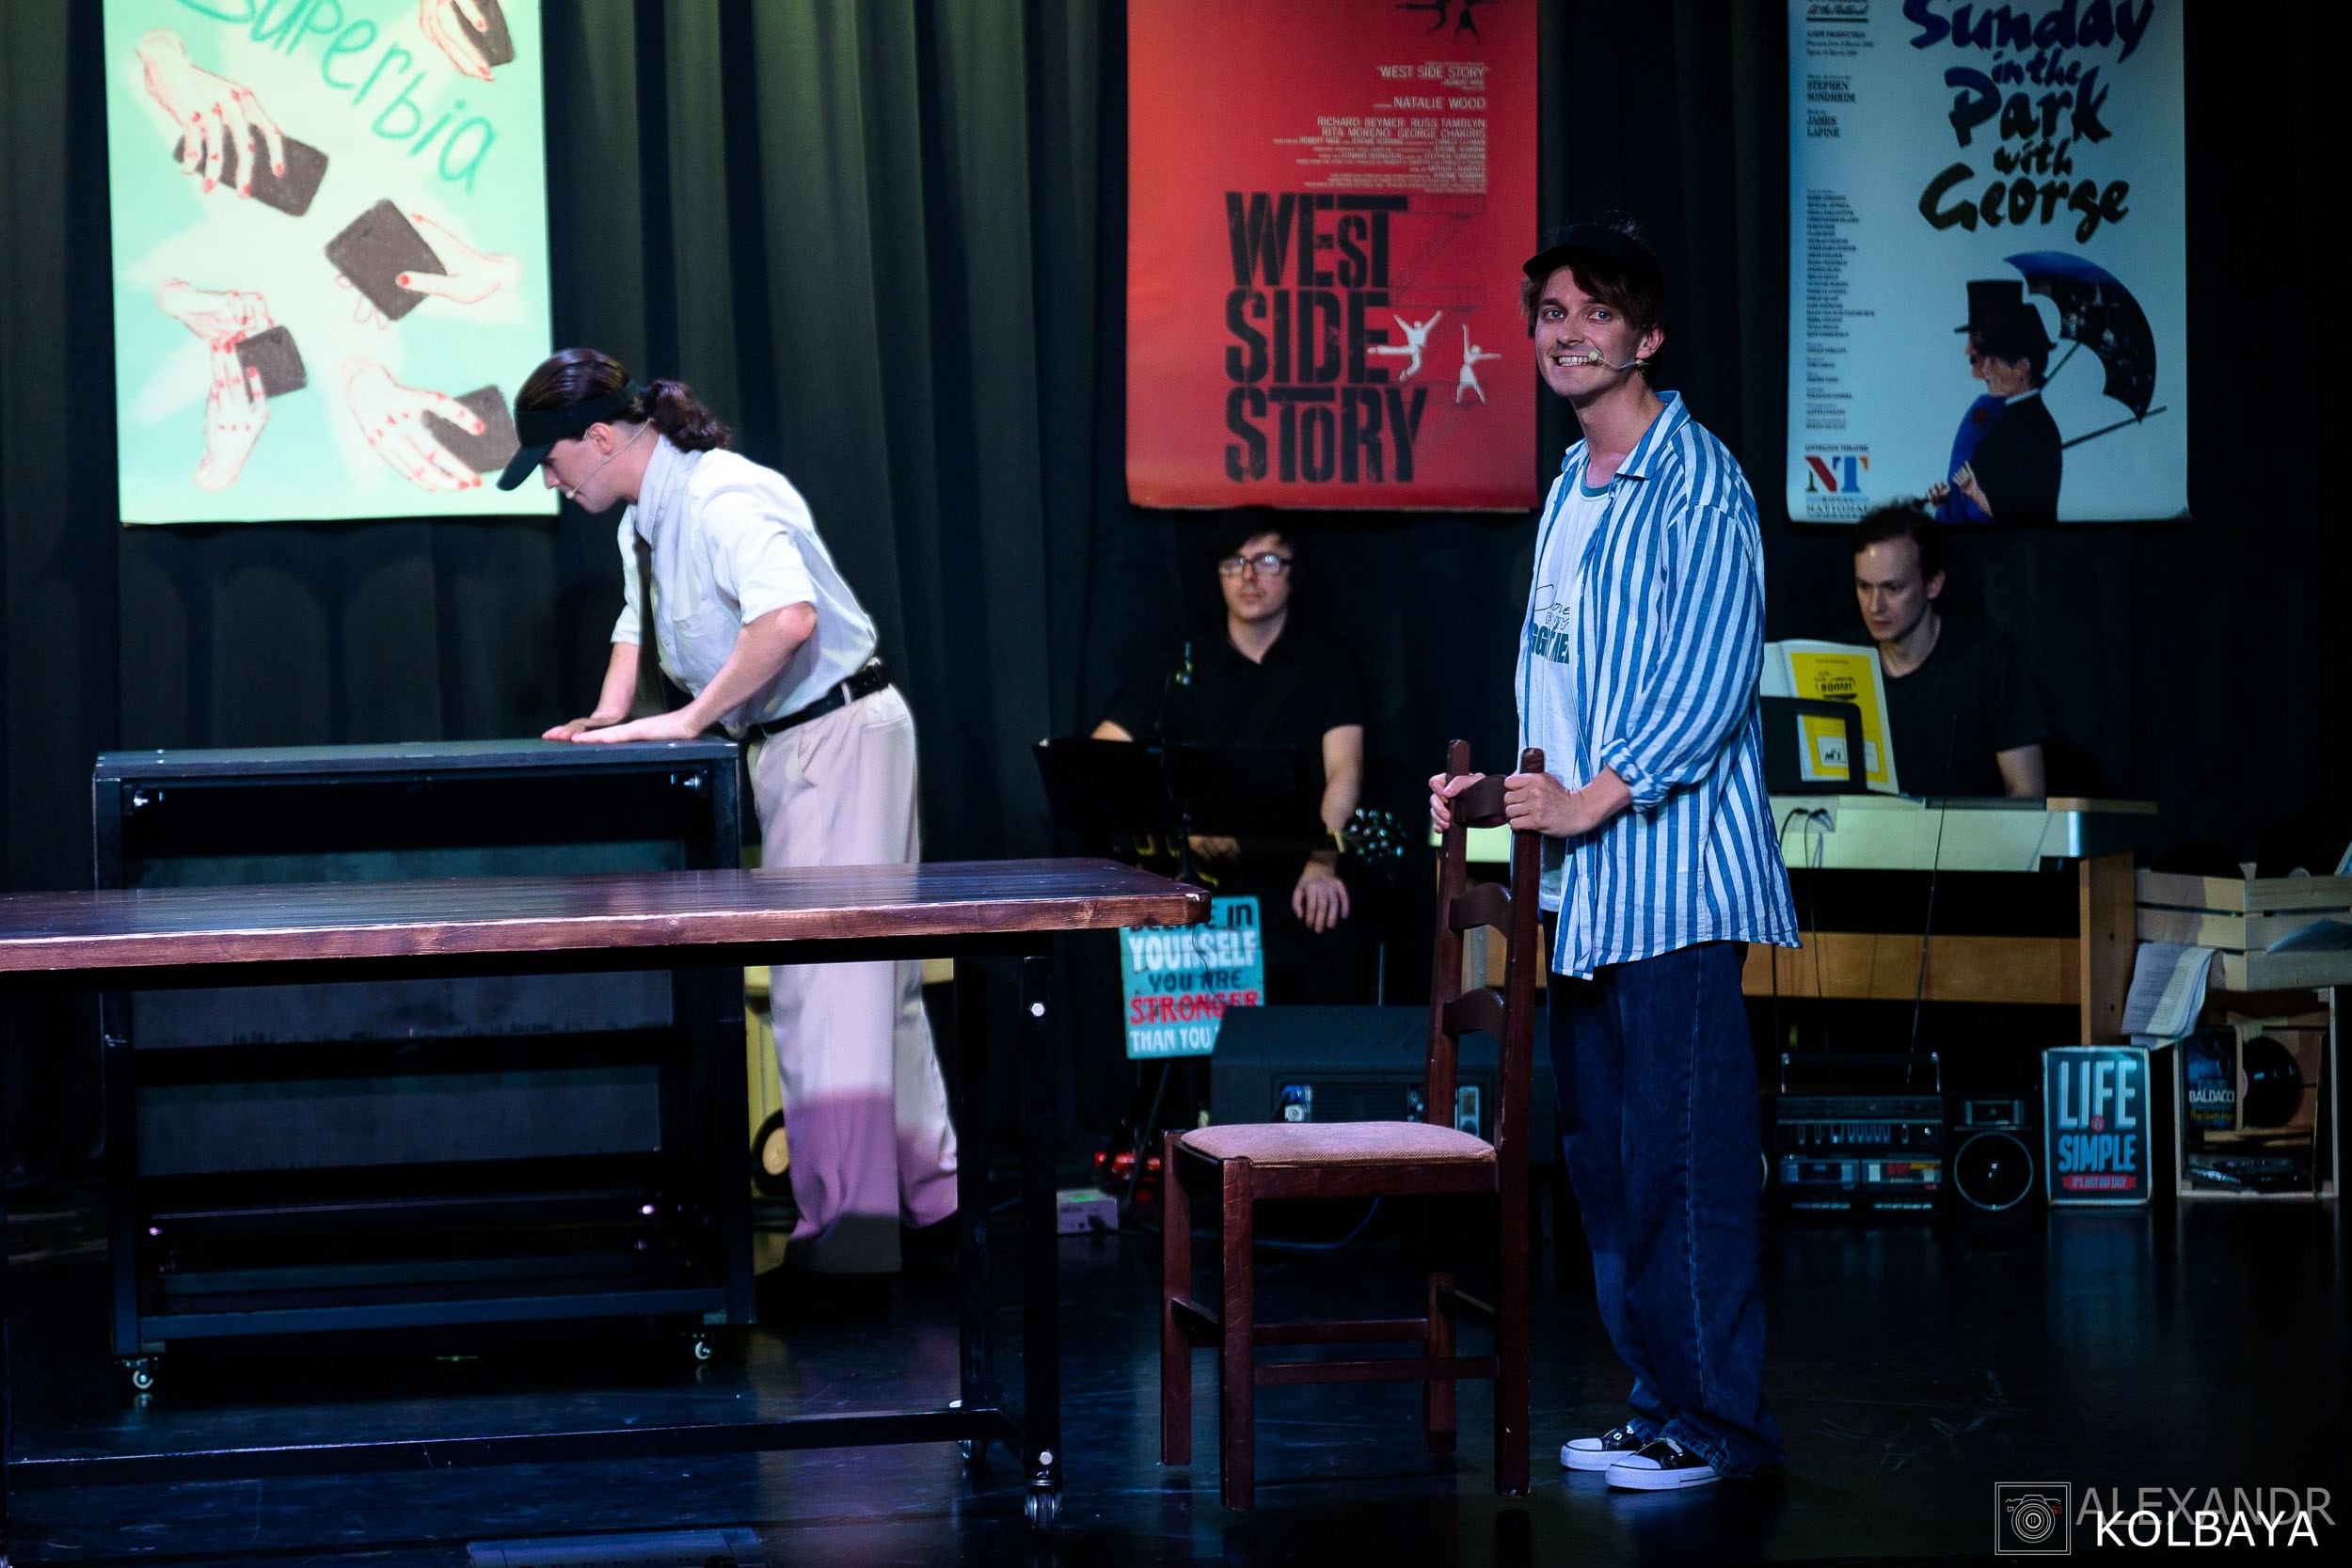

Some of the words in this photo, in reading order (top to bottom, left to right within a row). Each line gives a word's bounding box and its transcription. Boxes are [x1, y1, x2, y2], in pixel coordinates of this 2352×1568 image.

[1902, 0, 2154, 63] Sunday
[1417, 65, 1443, 79] SIDE
[1991, 51, 2026, 85] in
[2026, 49, 2081, 84] the
[1393, 96, 1444, 109] NATALIE
[1448, 96, 1486, 109] WOOD
[1806, 81, 1849, 90] STEPHEN
[1806, 92, 1856, 103] SONDHEIM
[1317, 117, 1359, 127] RICHARD
[1364, 117, 1404, 127] BEYMER
[1410, 118, 1438, 128] RUSS
[1441, 118, 1486, 128] TAMBLYN
[1806, 116, 1836, 125] JAMES
[1944, 65, 2112, 148] Park
[1322, 127, 1343, 137] RITA
[1347, 127, 1390, 137] MORENO
[1397, 127, 1437, 137] GEORGE
[1440, 128, 1486, 138] CHAKIRIS
[1806, 127, 1839, 136] LAPINE
[1993, 136, 2073, 176] with
[1918, 161, 2130, 245] George
[1224, 192, 1408, 288] WEST
[1224, 289, 1390, 385] SIDE
[1224, 386, 1428, 483] STORY
[1804, 455, 1868, 493] NT
[1128, 929, 1257, 972] YOURSELF
[1148, 972, 1192, 993] YOU
[1129, 990, 1259, 1025] STRONGER
[1130, 1028, 1175, 1053] THAN
[1179, 1025, 1211, 1052] YOU
[2058, 1060, 2137, 1130] LIFE
[2188, 1089, 2235, 1103] BALDACCI
[2058, 1133, 2137, 1173] SIMPLE
